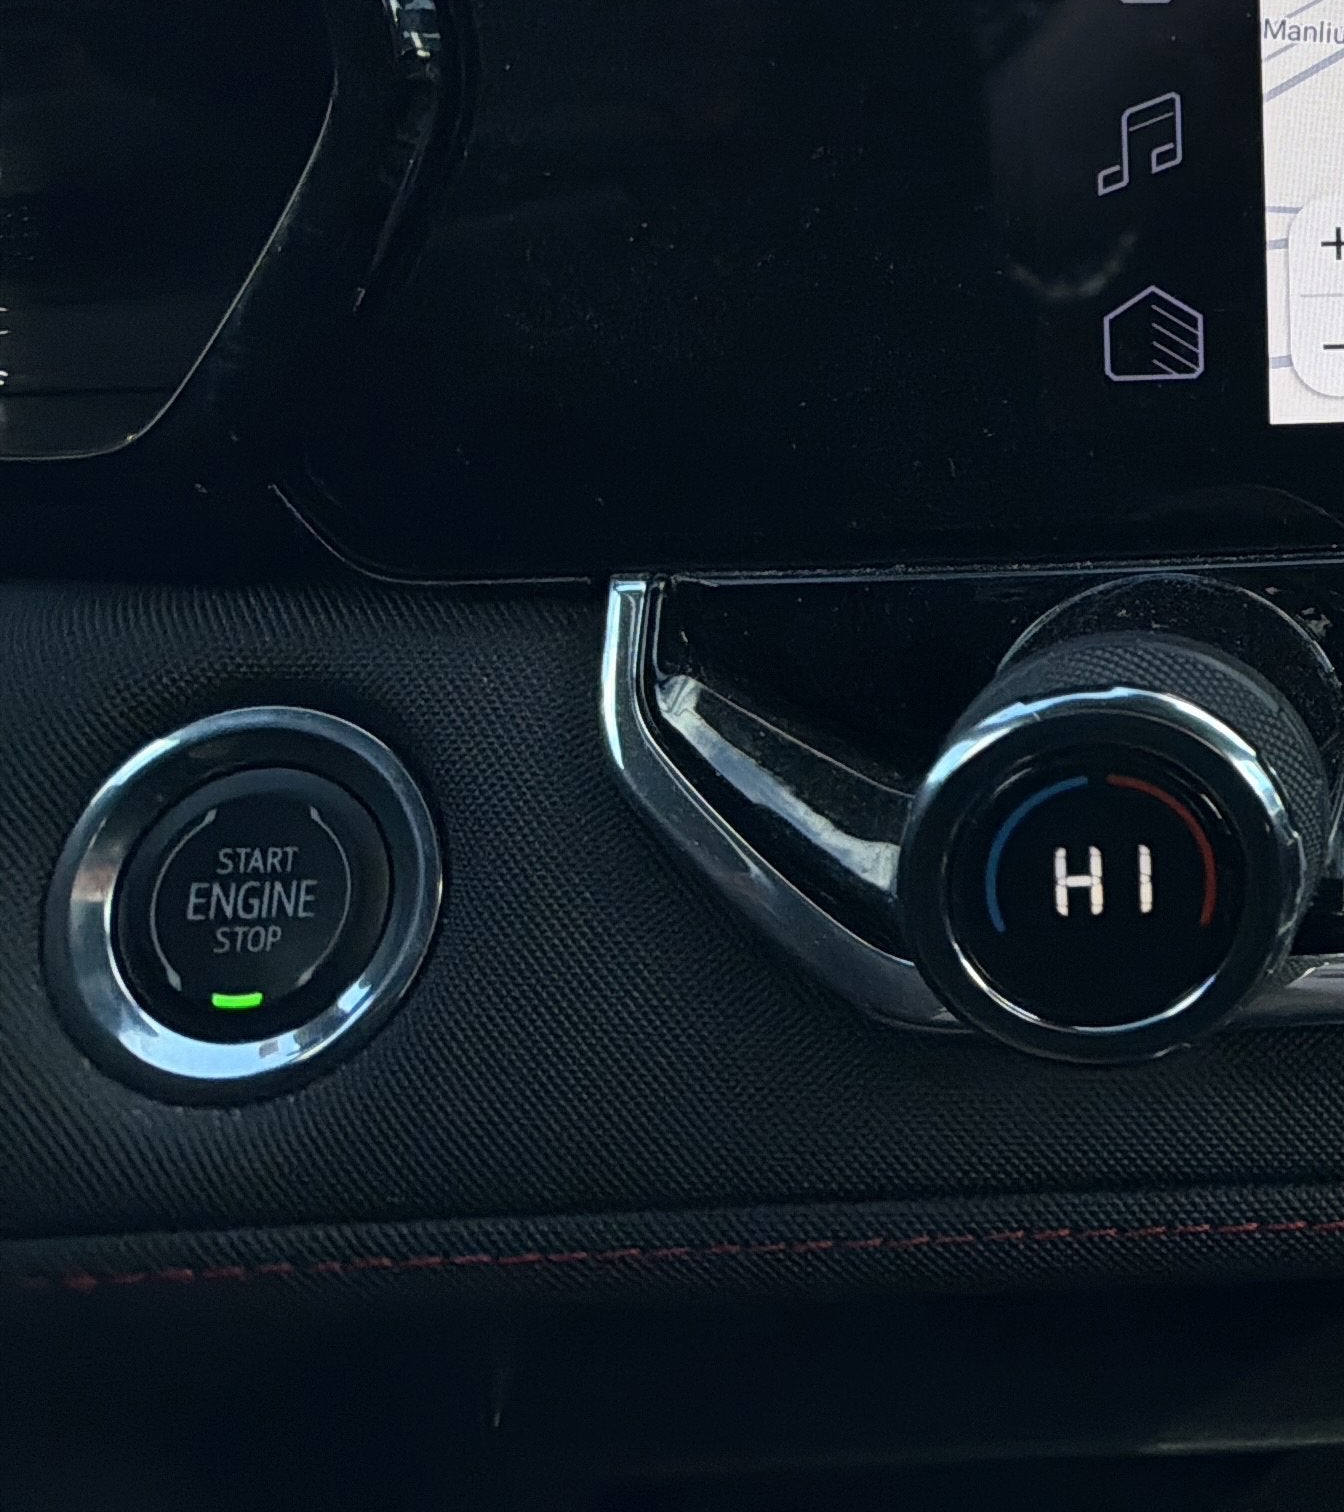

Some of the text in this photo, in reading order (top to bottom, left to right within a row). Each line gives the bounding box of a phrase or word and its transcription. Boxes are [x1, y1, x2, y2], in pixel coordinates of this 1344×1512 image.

[216, 847, 298, 875] START
[185, 879, 318, 923] ENGINE
[211, 924, 283, 956] STOP
